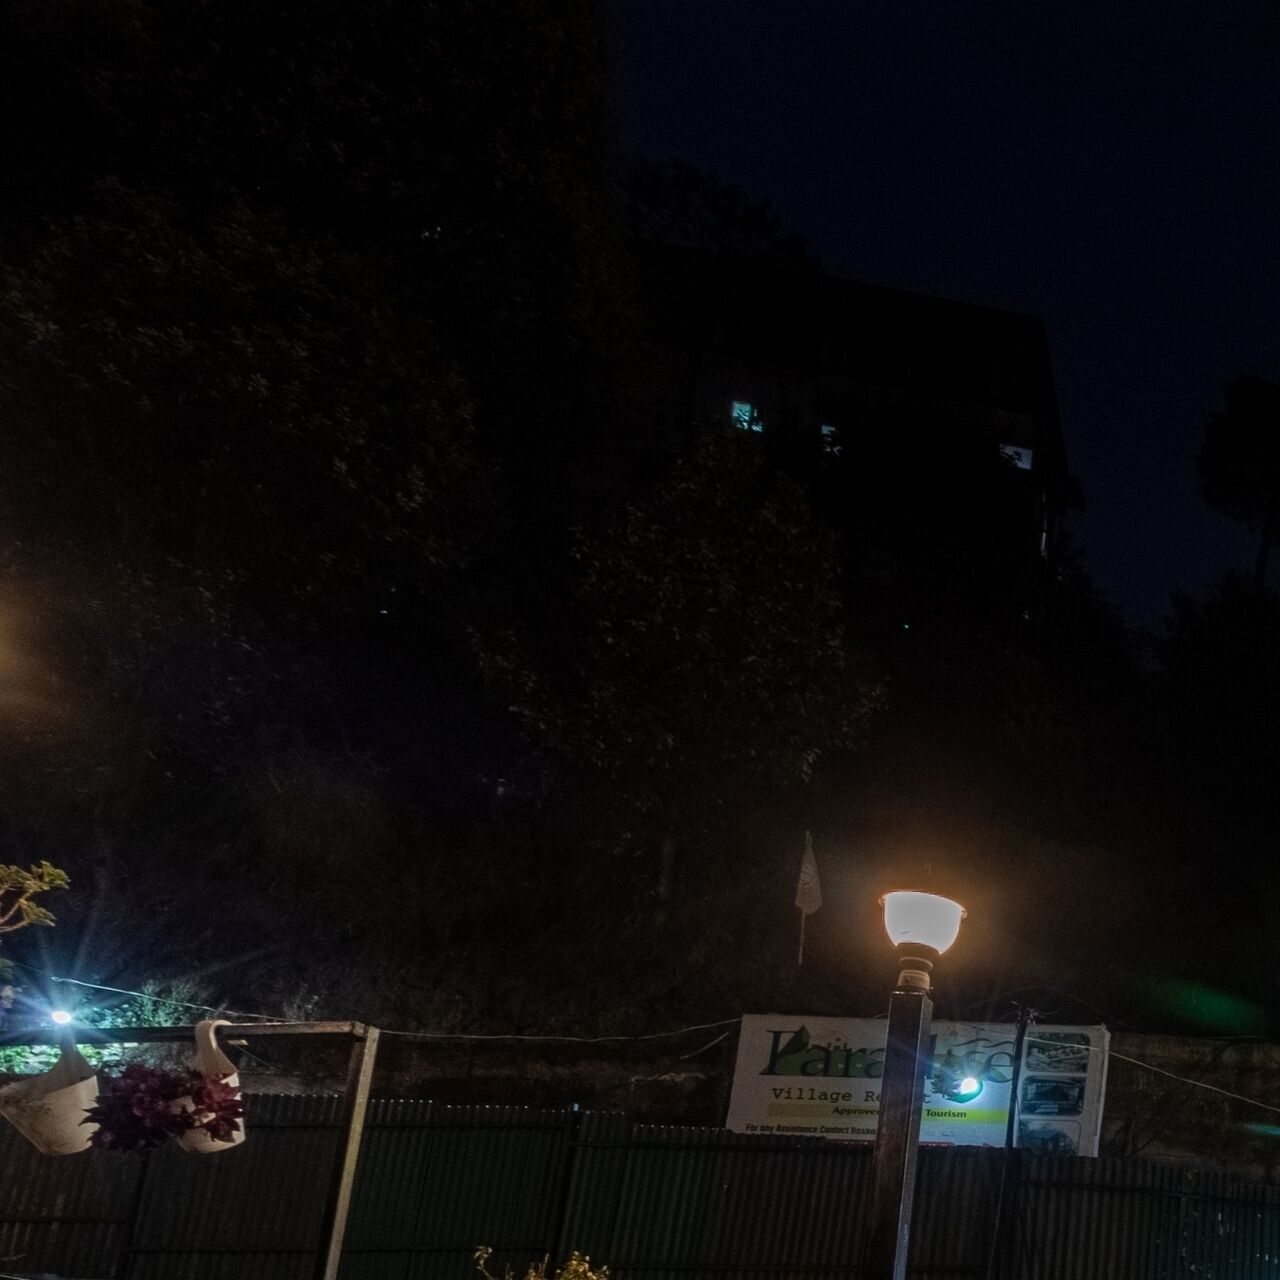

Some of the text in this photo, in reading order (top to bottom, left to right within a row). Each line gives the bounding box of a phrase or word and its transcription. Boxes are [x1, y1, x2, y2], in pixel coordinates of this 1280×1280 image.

[772, 1088, 852, 1103] Village
[832, 1106, 967, 1118] Approve Tourism
